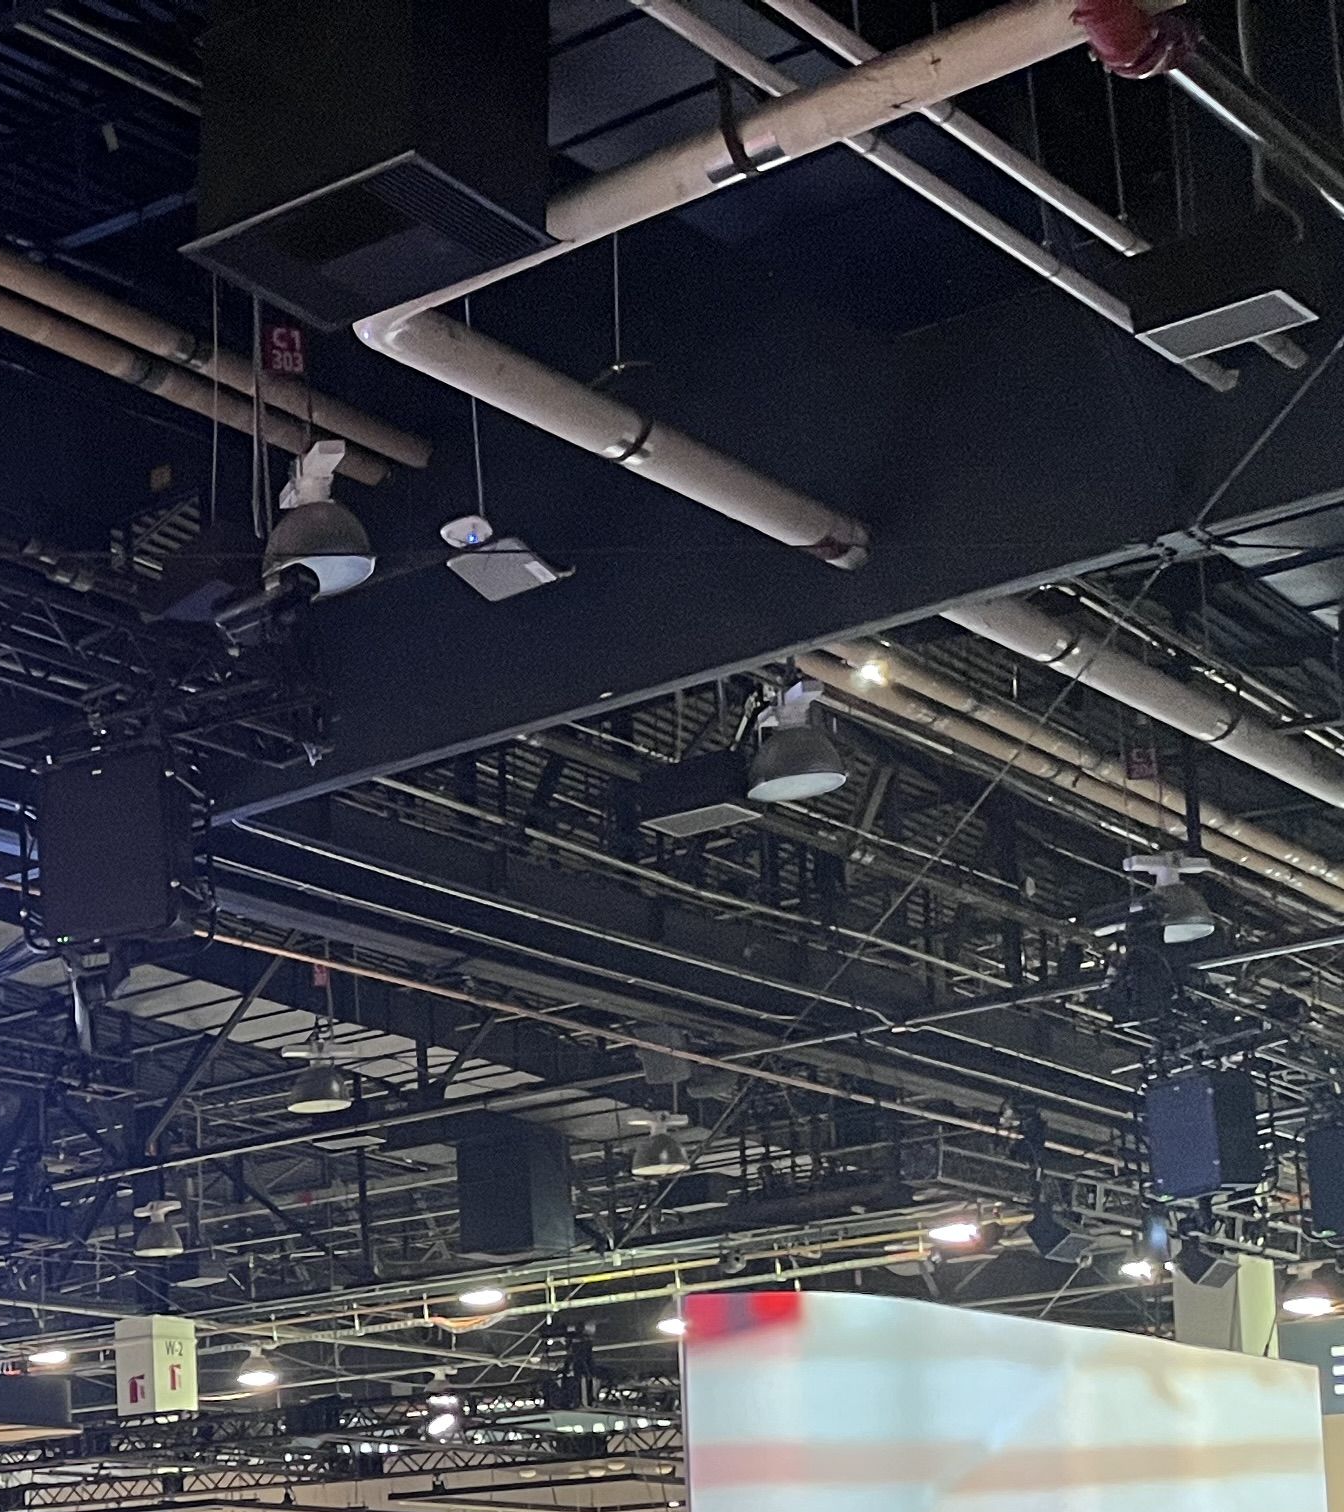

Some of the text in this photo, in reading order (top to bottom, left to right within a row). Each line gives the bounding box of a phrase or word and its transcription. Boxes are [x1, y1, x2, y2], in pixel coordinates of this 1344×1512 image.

[273, 327, 301, 351] C1
[272, 349, 304, 373] 303
[165, 1340, 184, 1356] W-2
